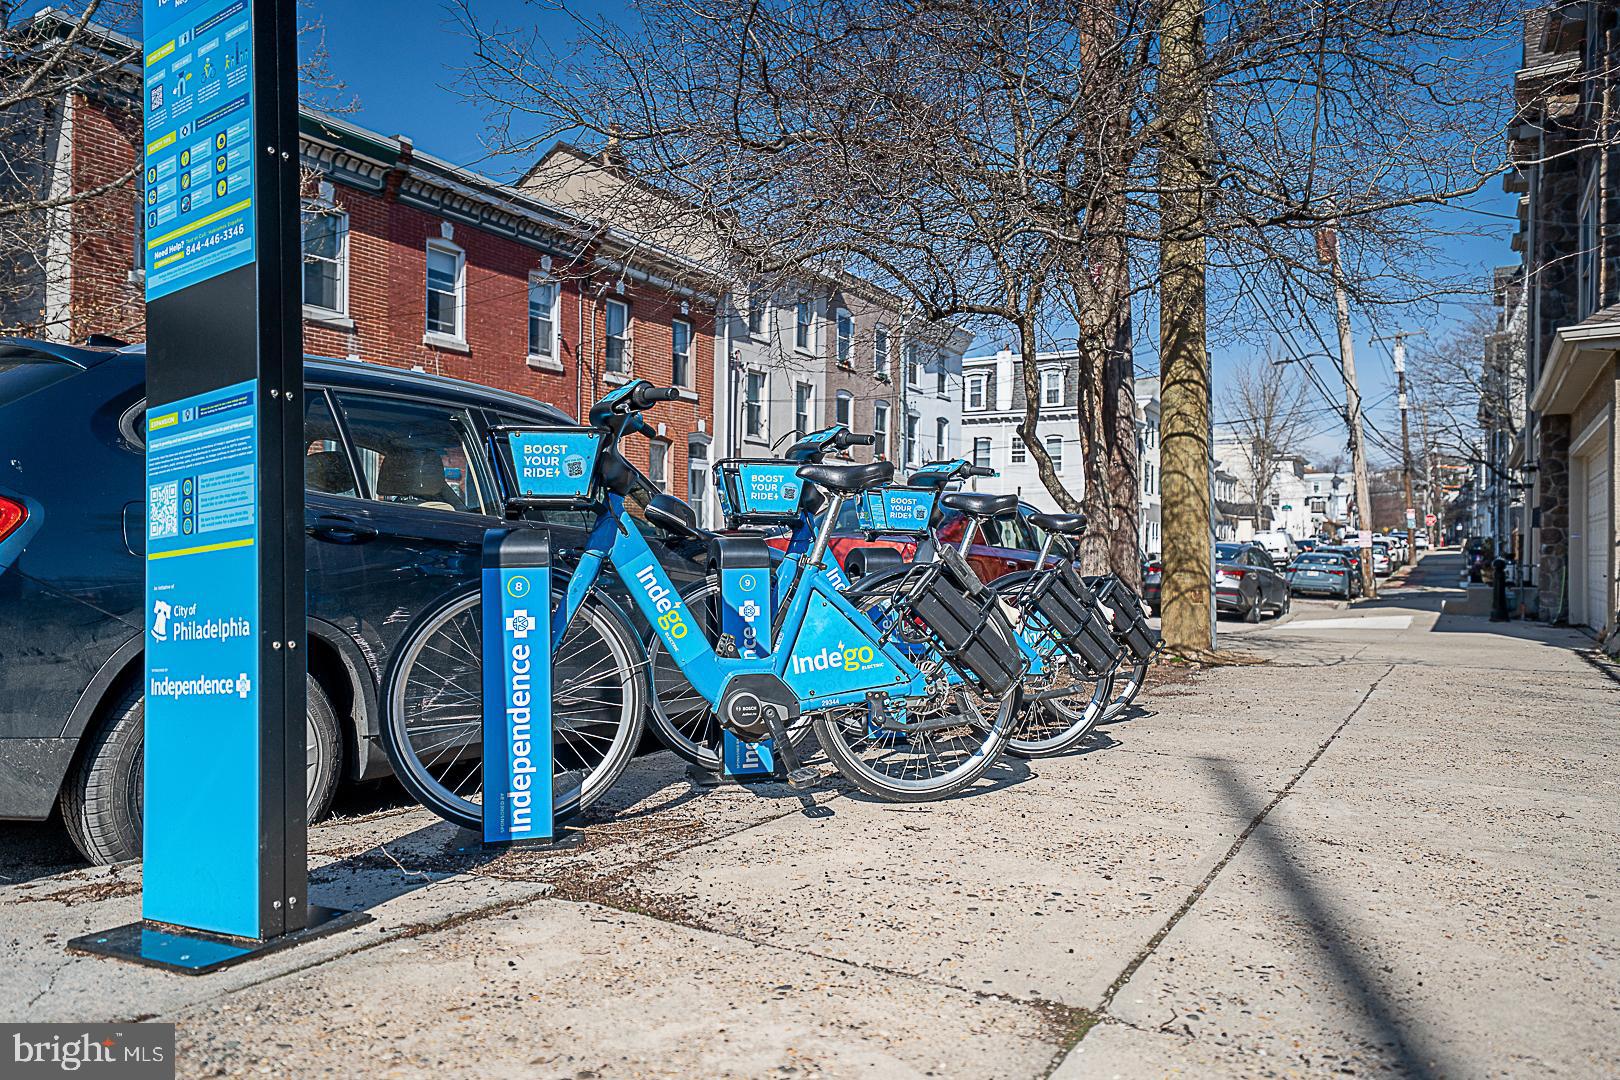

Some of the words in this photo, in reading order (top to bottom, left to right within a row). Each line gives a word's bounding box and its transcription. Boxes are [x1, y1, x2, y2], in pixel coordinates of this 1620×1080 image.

[186, 224, 244, 256] 844-446-3346
[154, 247, 168, 260] Need
[169, 241, 185, 254] Help?
[524, 445, 568, 454] BOOST
[524, 456, 559, 466] YOUR
[524, 468, 553, 478] RIDE
[751, 474, 784, 482] BOOST
[751, 483, 778, 491] YOUR
[751, 492, 773, 500] RIDE
[515, 581, 523, 592] 8
[744, 579, 751, 587] 9
[636, 564, 688, 639] Indego
[173, 605, 188, 619] City
[188, 603, 197, 616] of
[173, 617, 250, 642] Philadelphia
[792, 645, 874, 675] Indego
[151, 675, 234, 700] Independence
[507, 644, 537, 833] Independence
